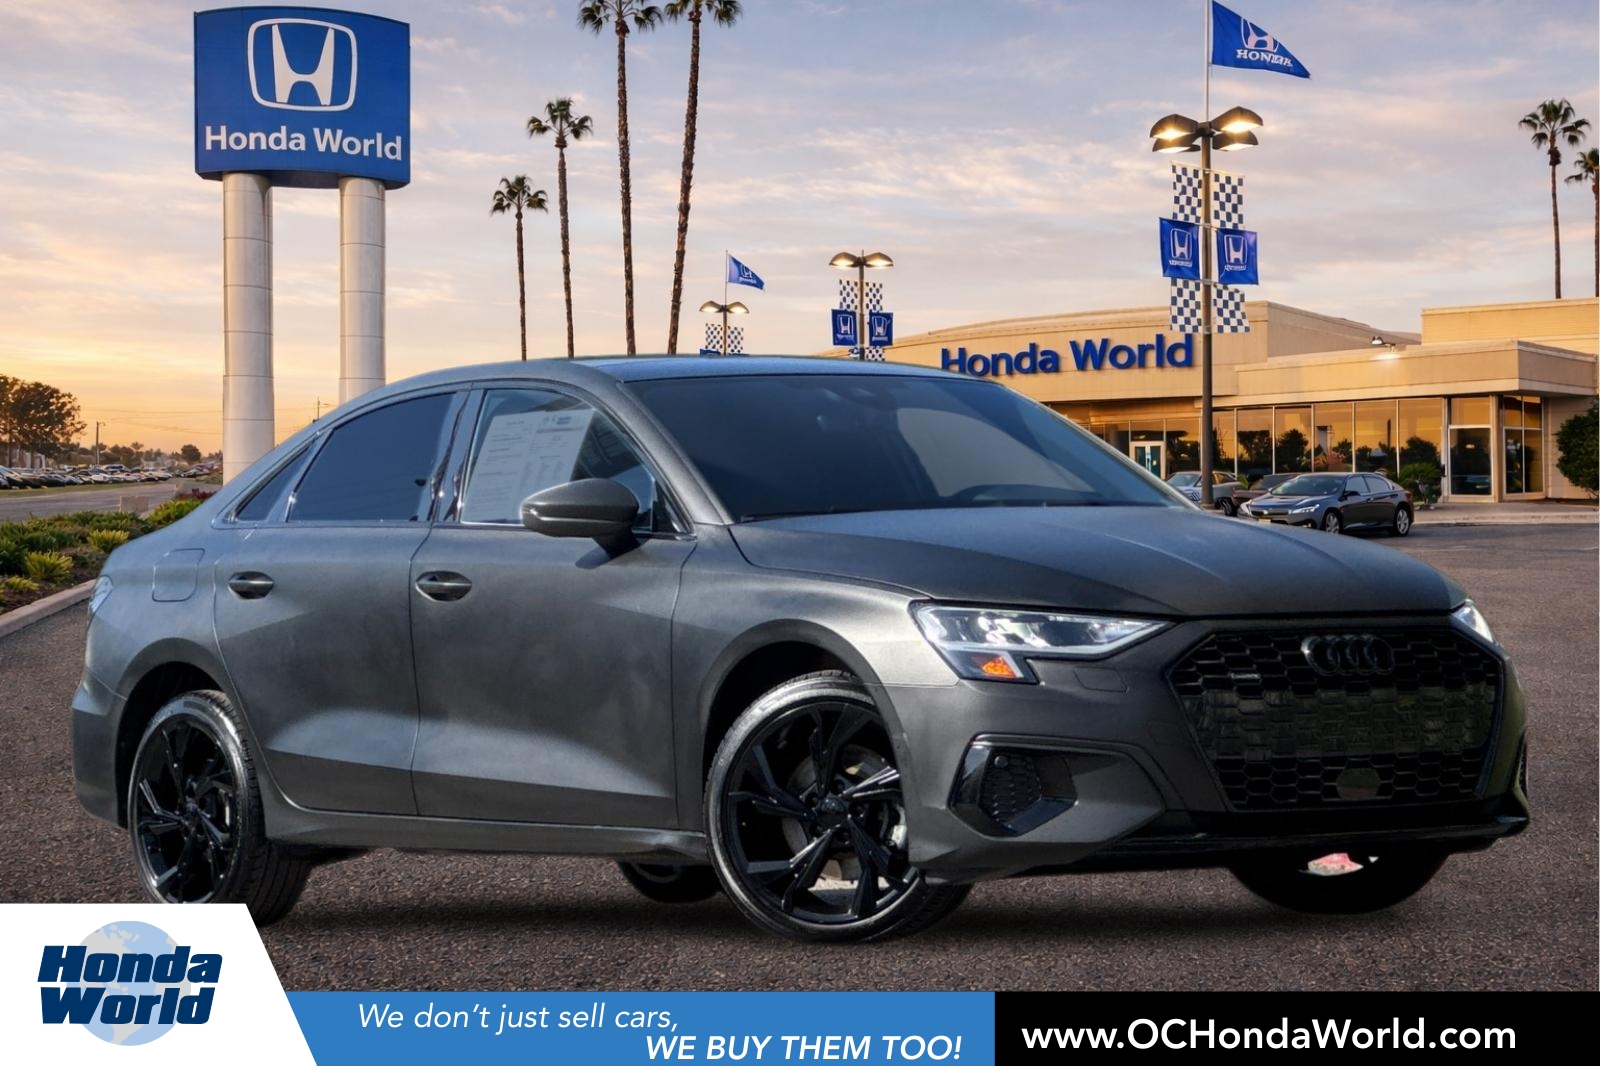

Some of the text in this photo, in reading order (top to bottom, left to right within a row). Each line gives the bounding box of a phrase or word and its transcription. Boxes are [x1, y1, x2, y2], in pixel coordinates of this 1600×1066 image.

[205, 125, 402, 161] Honda World
[941, 333, 1193, 376] Honda World
